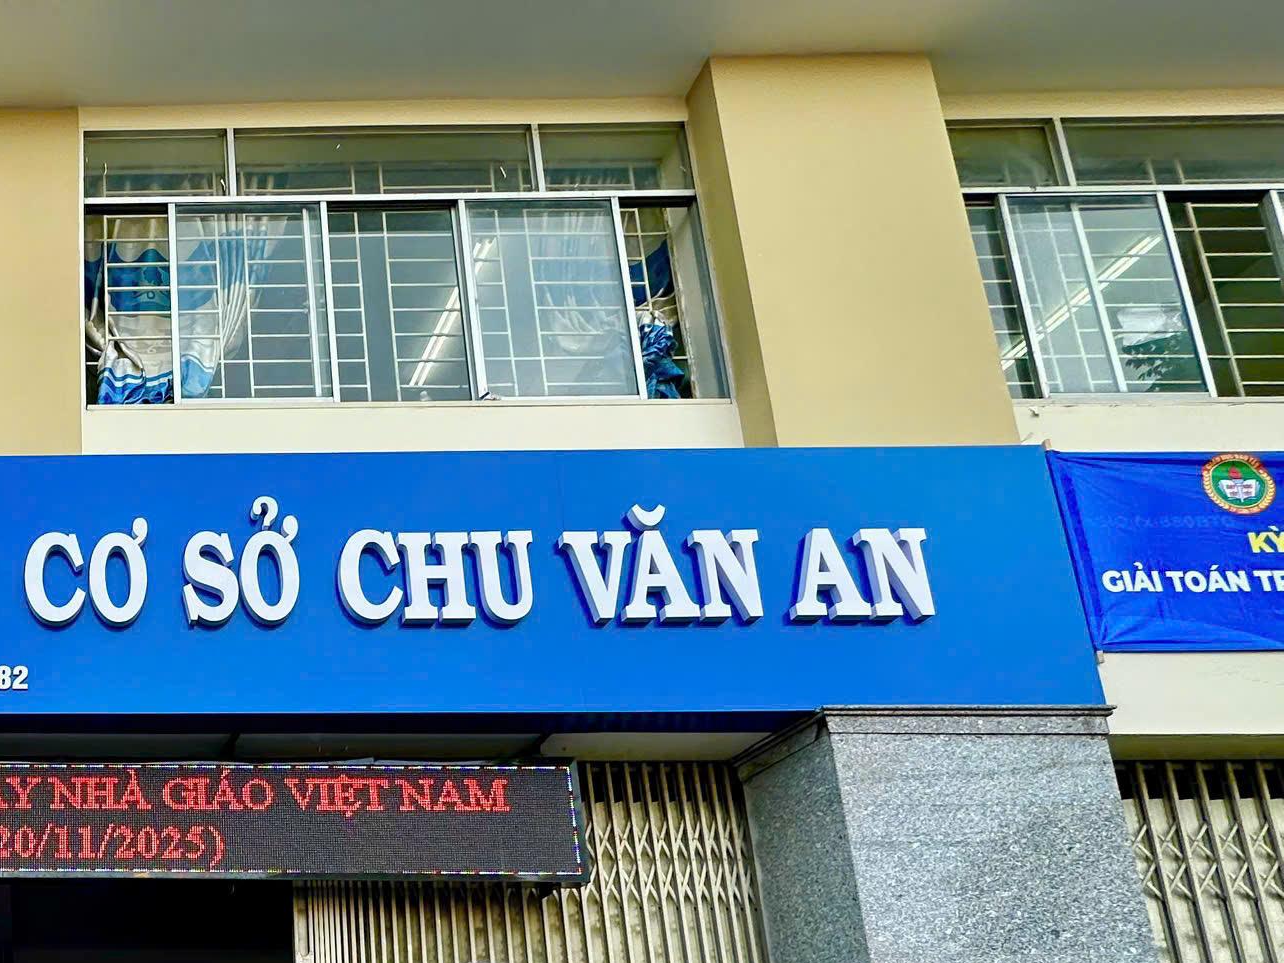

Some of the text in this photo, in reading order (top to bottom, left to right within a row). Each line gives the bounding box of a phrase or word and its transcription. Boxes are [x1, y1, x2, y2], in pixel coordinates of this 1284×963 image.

[24, 517, 148, 626] CƠ
[183, 495, 300, 625] SỞ
[337, 528, 534, 623] CHU
[558, 503, 764, 625] VĂN
[789, 527, 936, 623] AN
[1102, 562, 1164, 593] GIẢI
[1166, 564, 1251, 593] TOÁN
[47, 766, 152, 811] NHÀ
[162, 768, 274, 811] GIÁO
[284, 774, 389, 818] VIỆT
[395, 778, 511, 812] NAM
